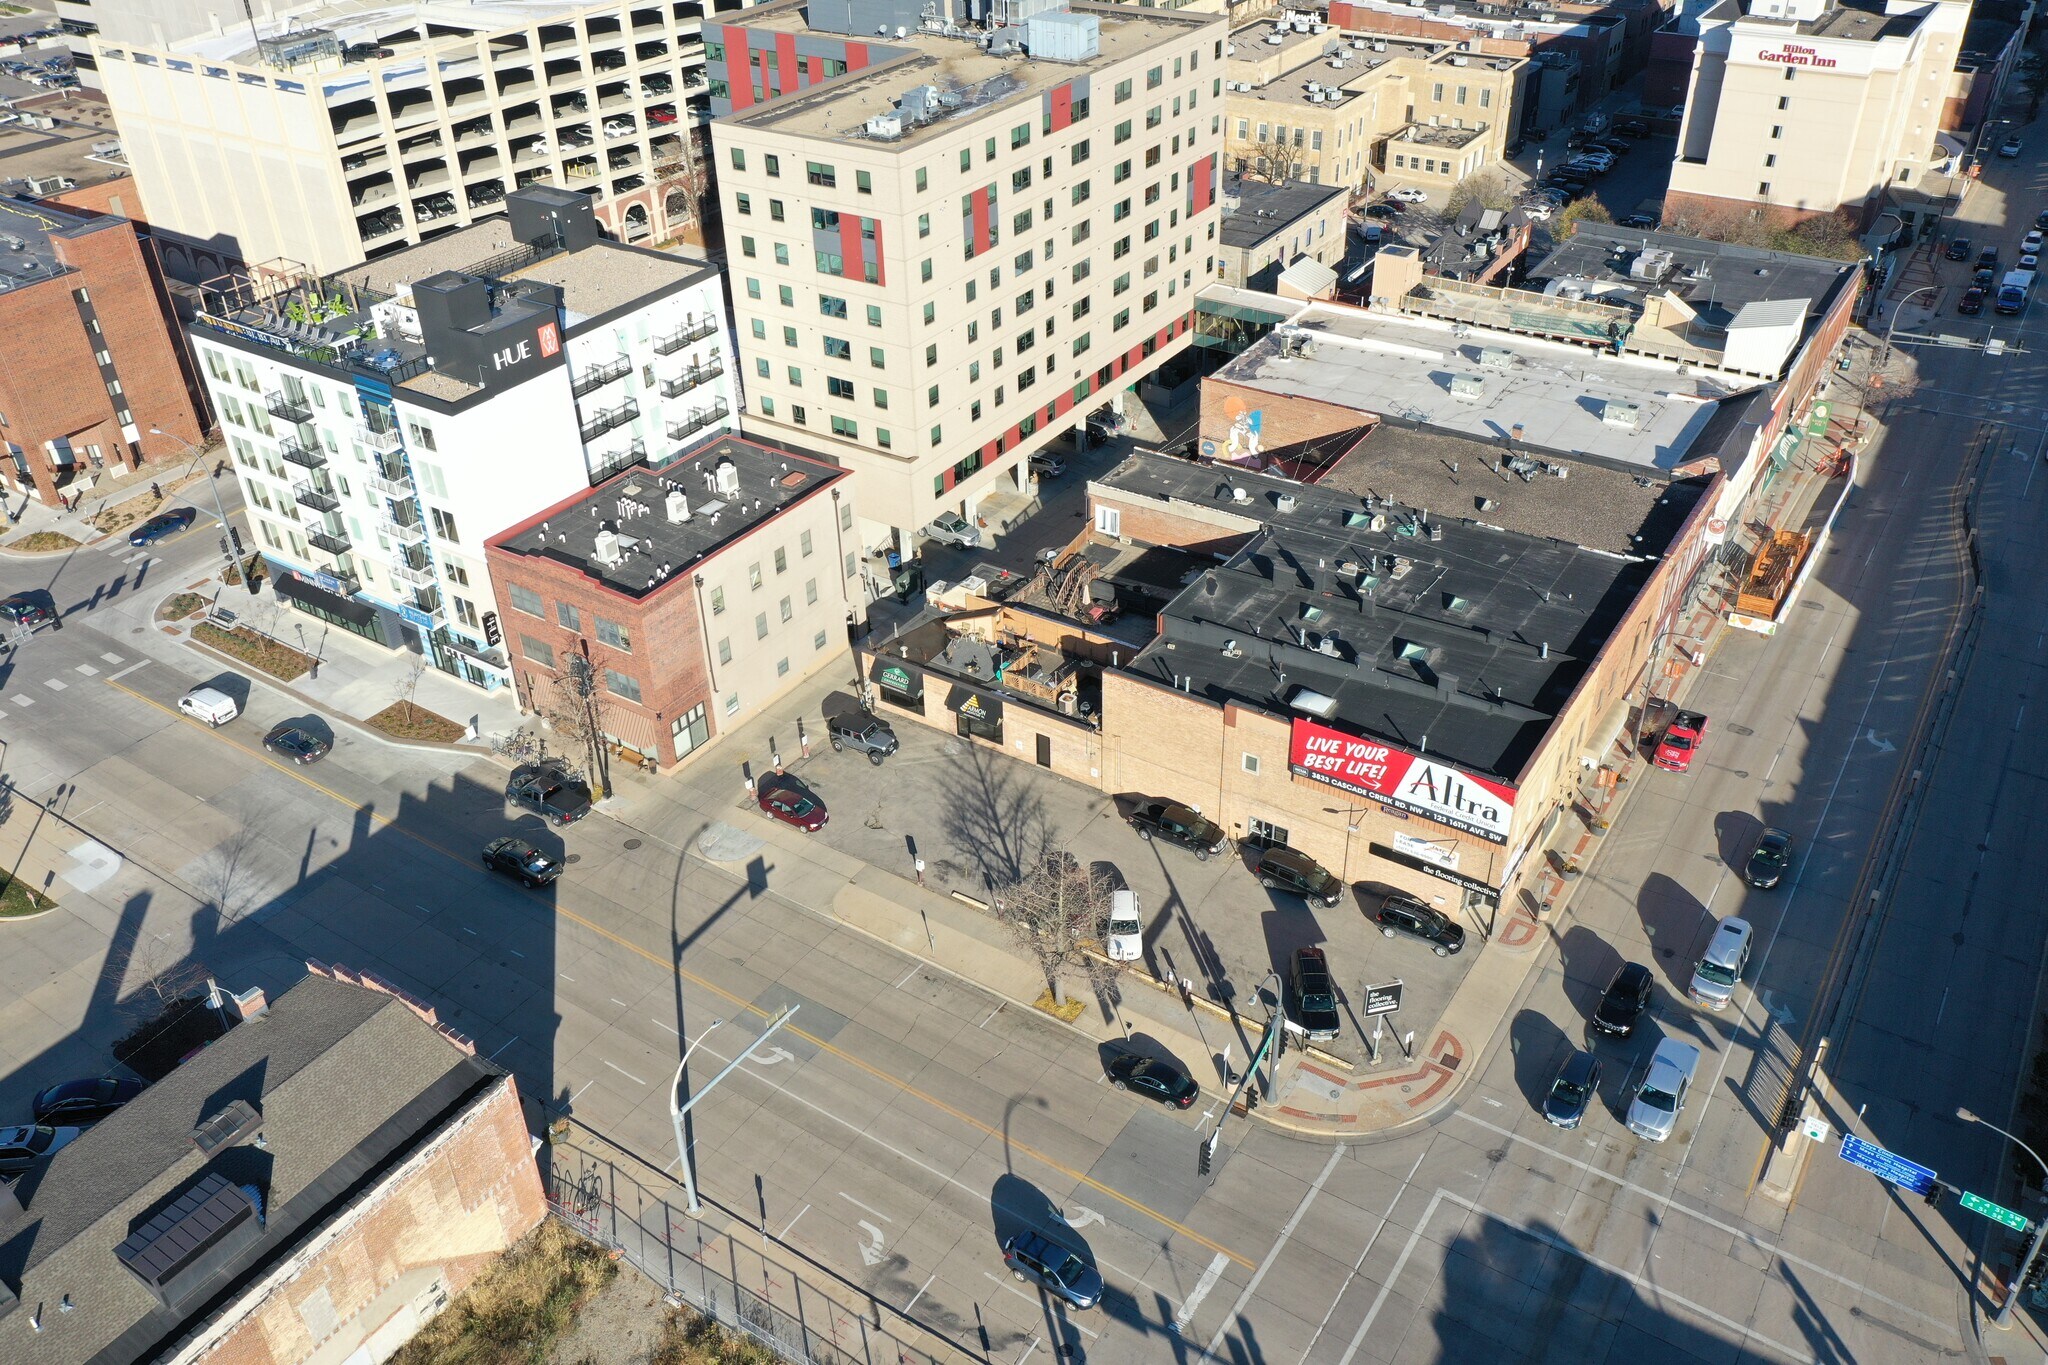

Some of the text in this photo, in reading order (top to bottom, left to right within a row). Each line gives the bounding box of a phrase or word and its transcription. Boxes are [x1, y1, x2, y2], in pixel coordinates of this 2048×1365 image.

[1758, 50, 1836, 68] Garden Inn
[1782, 44, 1816, 54] Hilton
[493, 340, 532, 370] HUE
[882, 672, 909, 686] GERRARD
[968, 706, 986, 716] ARMON
[1306, 736, 1388, 762] LIVE YOUR
[1304, 753, 1387, 780] BEST LIFE!
[1312, 772, 1502, 842] 3833 CASCADE CREEK RD. NW 123 16TH AVE. SW
[1408, 765, 1500, 823] Altra
[1431, 802, 1496, 829] Federal Credit Union
[1423, 866, 1499, 898] the flooring collective.
[1369, 995, 1392, 1004] flooring
[1860, 1146, 1874, 1156] Mayo
[1876, 1153, 1892, 1164] Clinic
[1894, 1161, 1918, 1176] Hospital
[1861, 1141, 1894, 1158] Mayo Clinic
[1856, 1154, 1872, 1163] Mayo
[1873, 1160, 1888, 1170] Clinic
[1890, 1168, 1914, 1182] Hospital
